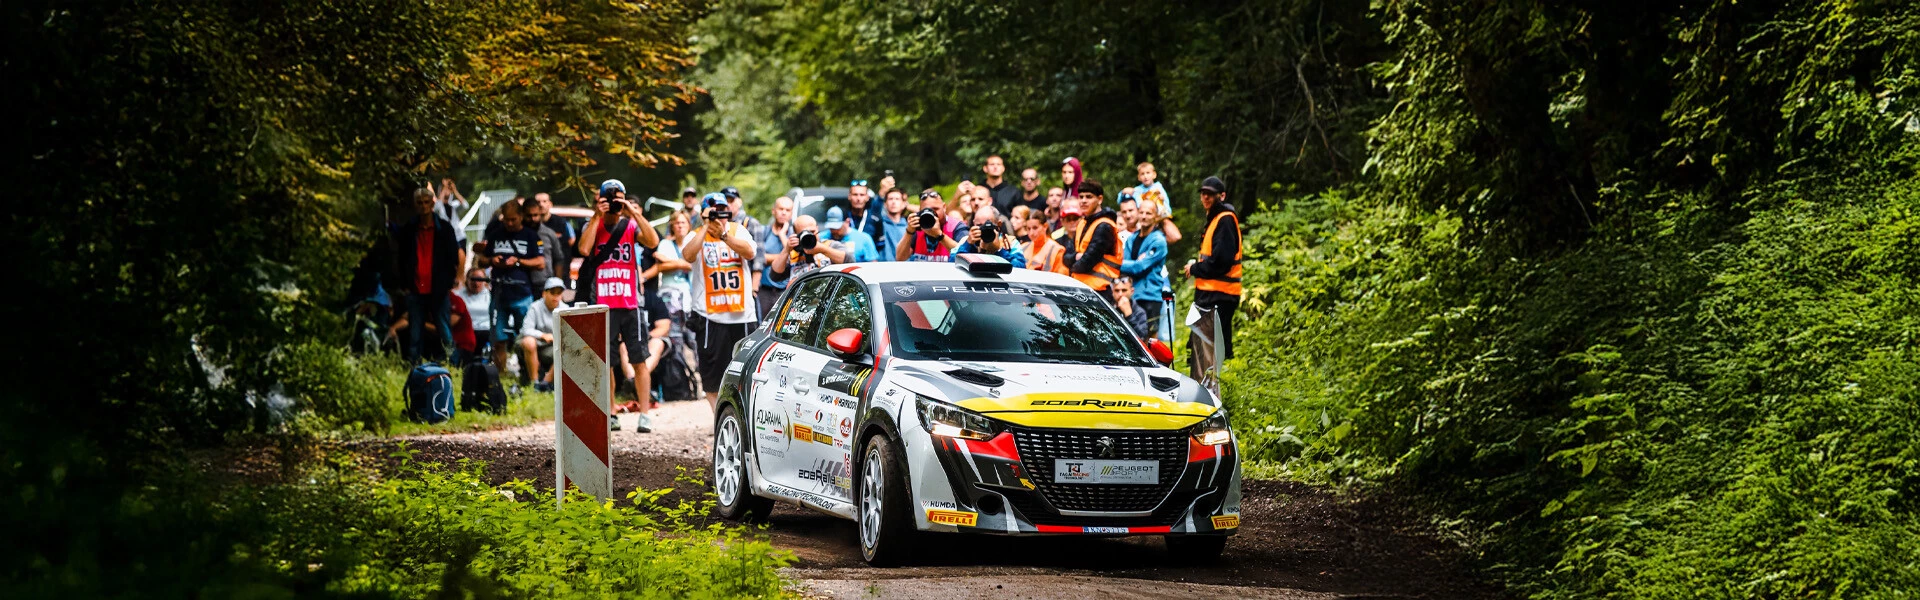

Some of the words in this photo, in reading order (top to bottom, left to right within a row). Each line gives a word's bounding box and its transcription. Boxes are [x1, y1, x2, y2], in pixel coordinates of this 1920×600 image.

[932, 286, 1061, 298] PEUGEOT
[774, 351, 796, 362] PEAK
[794, 425, 812, 442] PIRELLI
[780, 488, 801, 499] RACING
[801, 492, 837, 510] TECHNOLOGY
[930, 501, 956, 509] HUMDA
[928, 510, 974, 524] PIRELLI
[1213, 516, 1239, 528] PIRELLI
